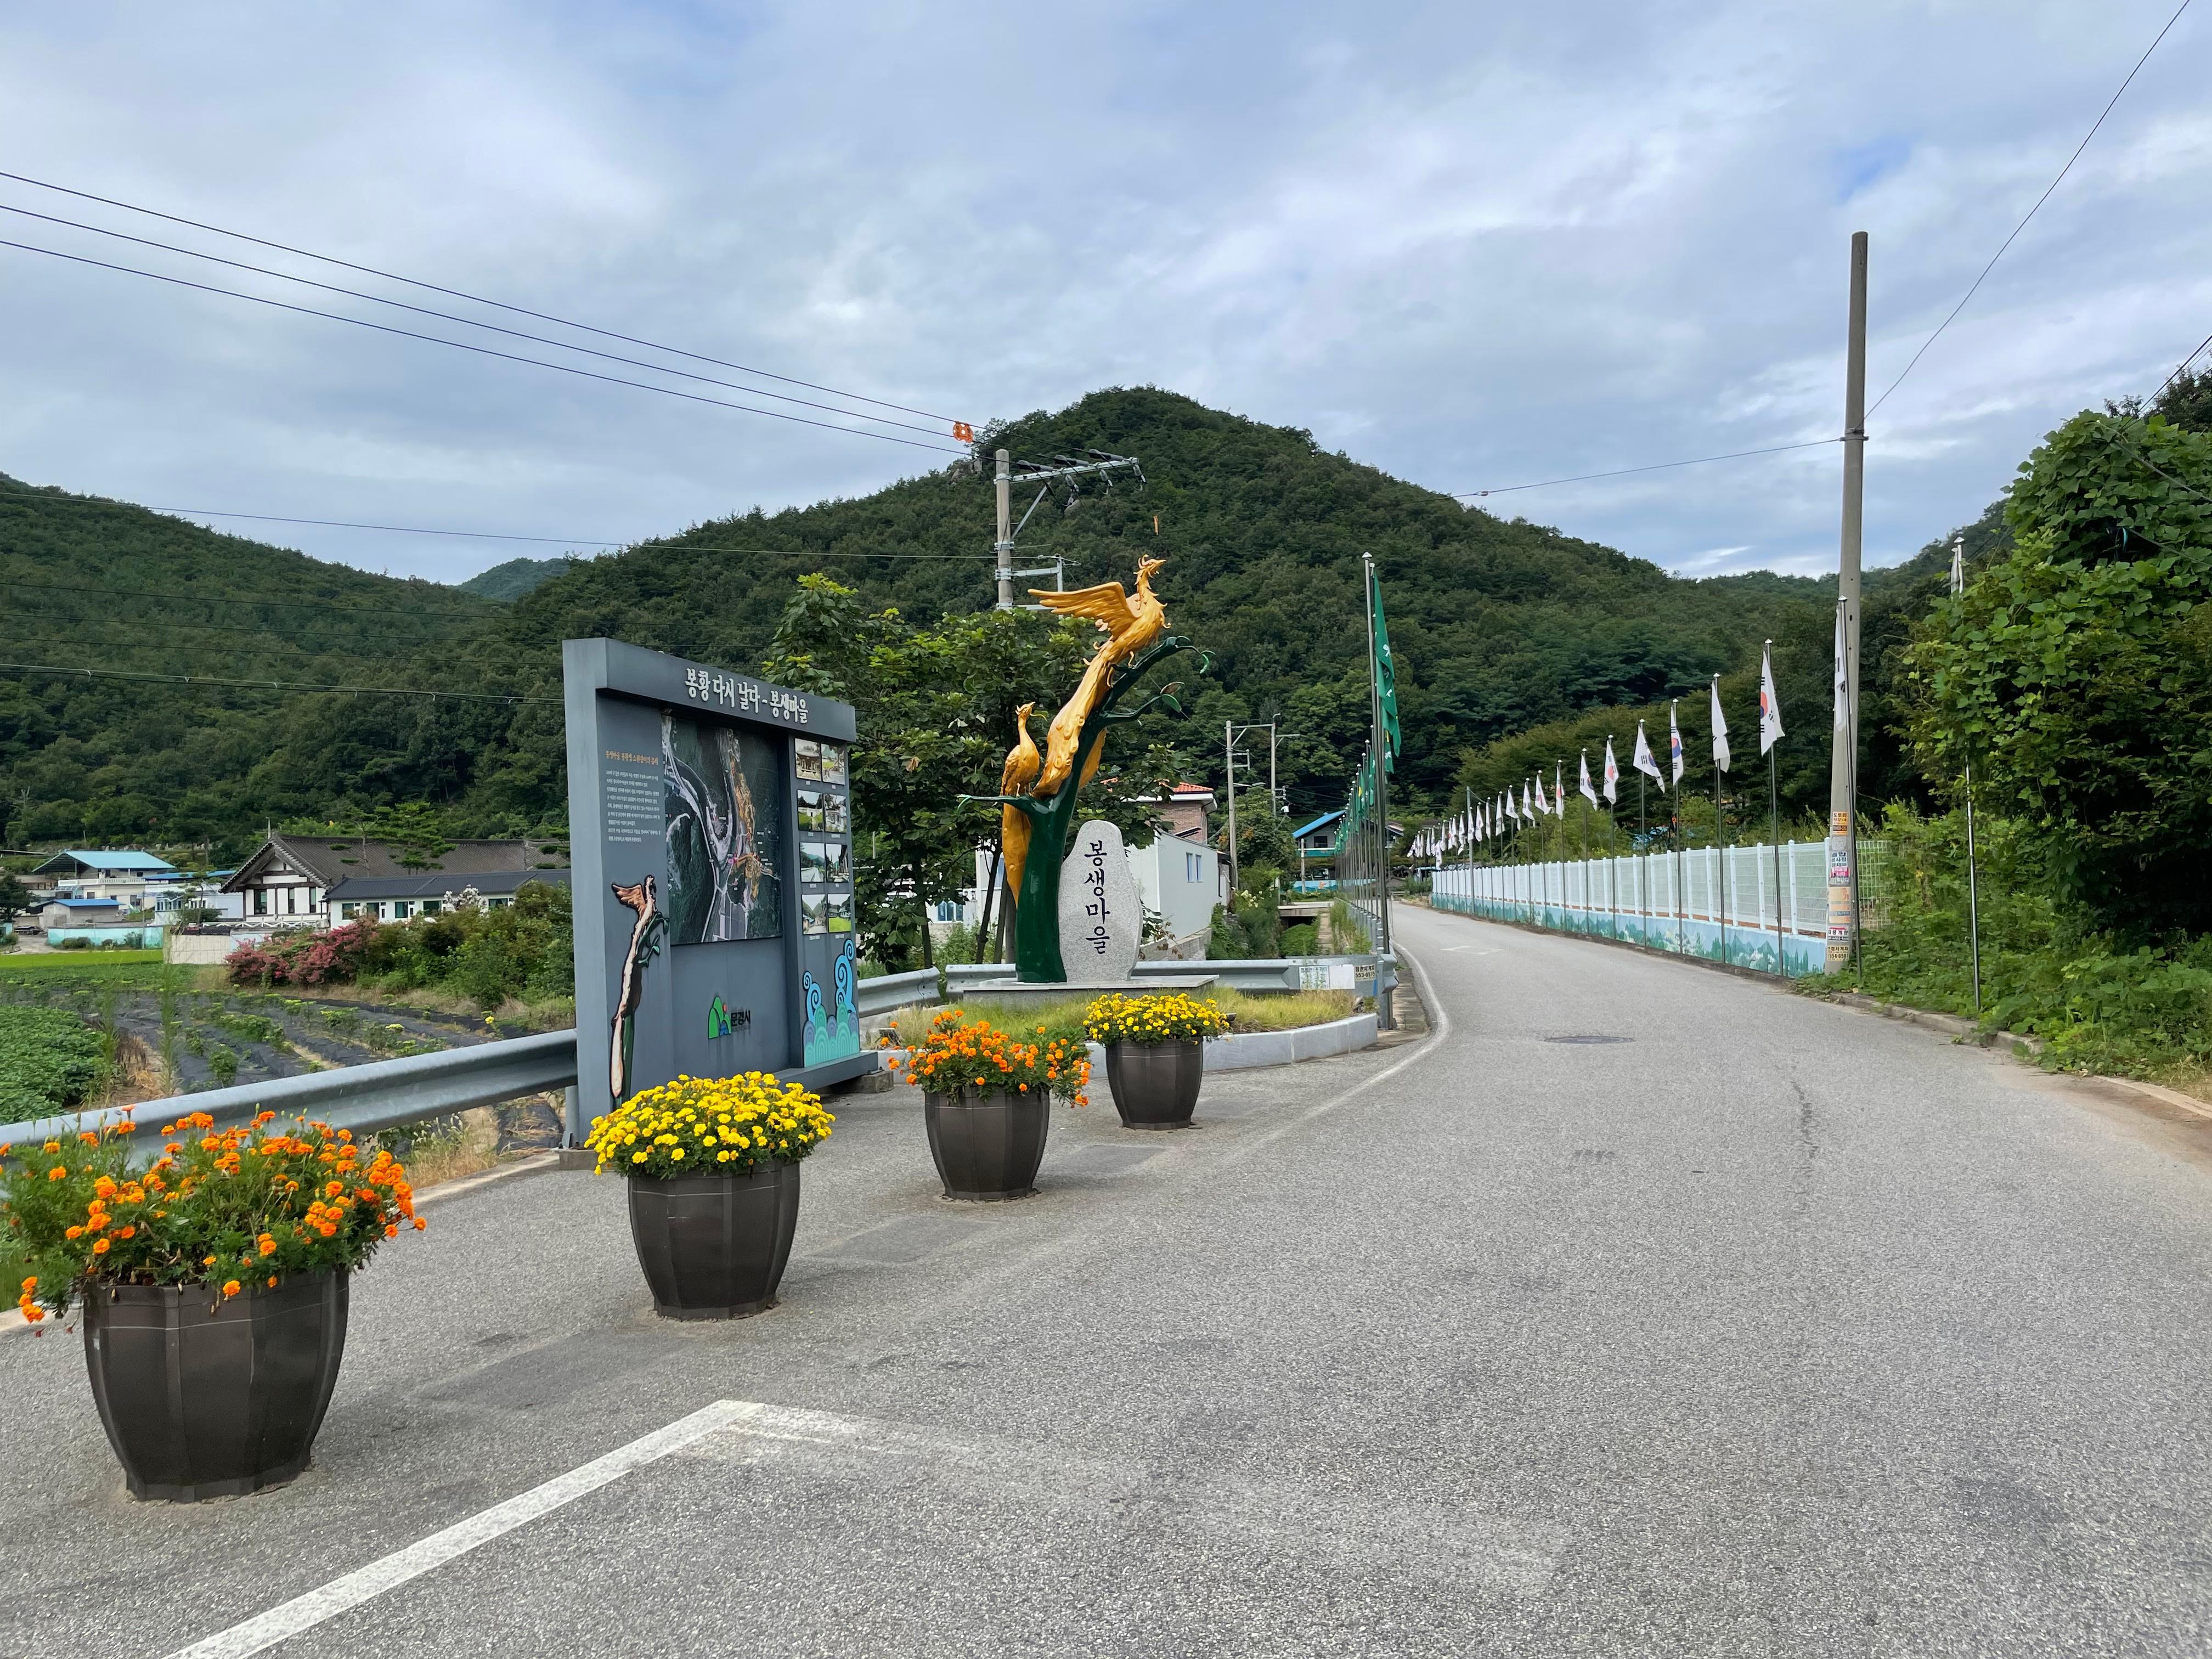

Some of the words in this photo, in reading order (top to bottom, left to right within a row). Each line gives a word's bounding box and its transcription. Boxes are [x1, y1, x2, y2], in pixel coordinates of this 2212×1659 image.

[685, 668, 710, 701] 봉황
[712, 675, 735, 708] 다시
[737, 681, 760, 713] 날다
[769, 691, 808, 724] 봉생마을
[1083, 840, 1110, 955] 봉생마을
[731, 1010, 751, 1026] 문경시
